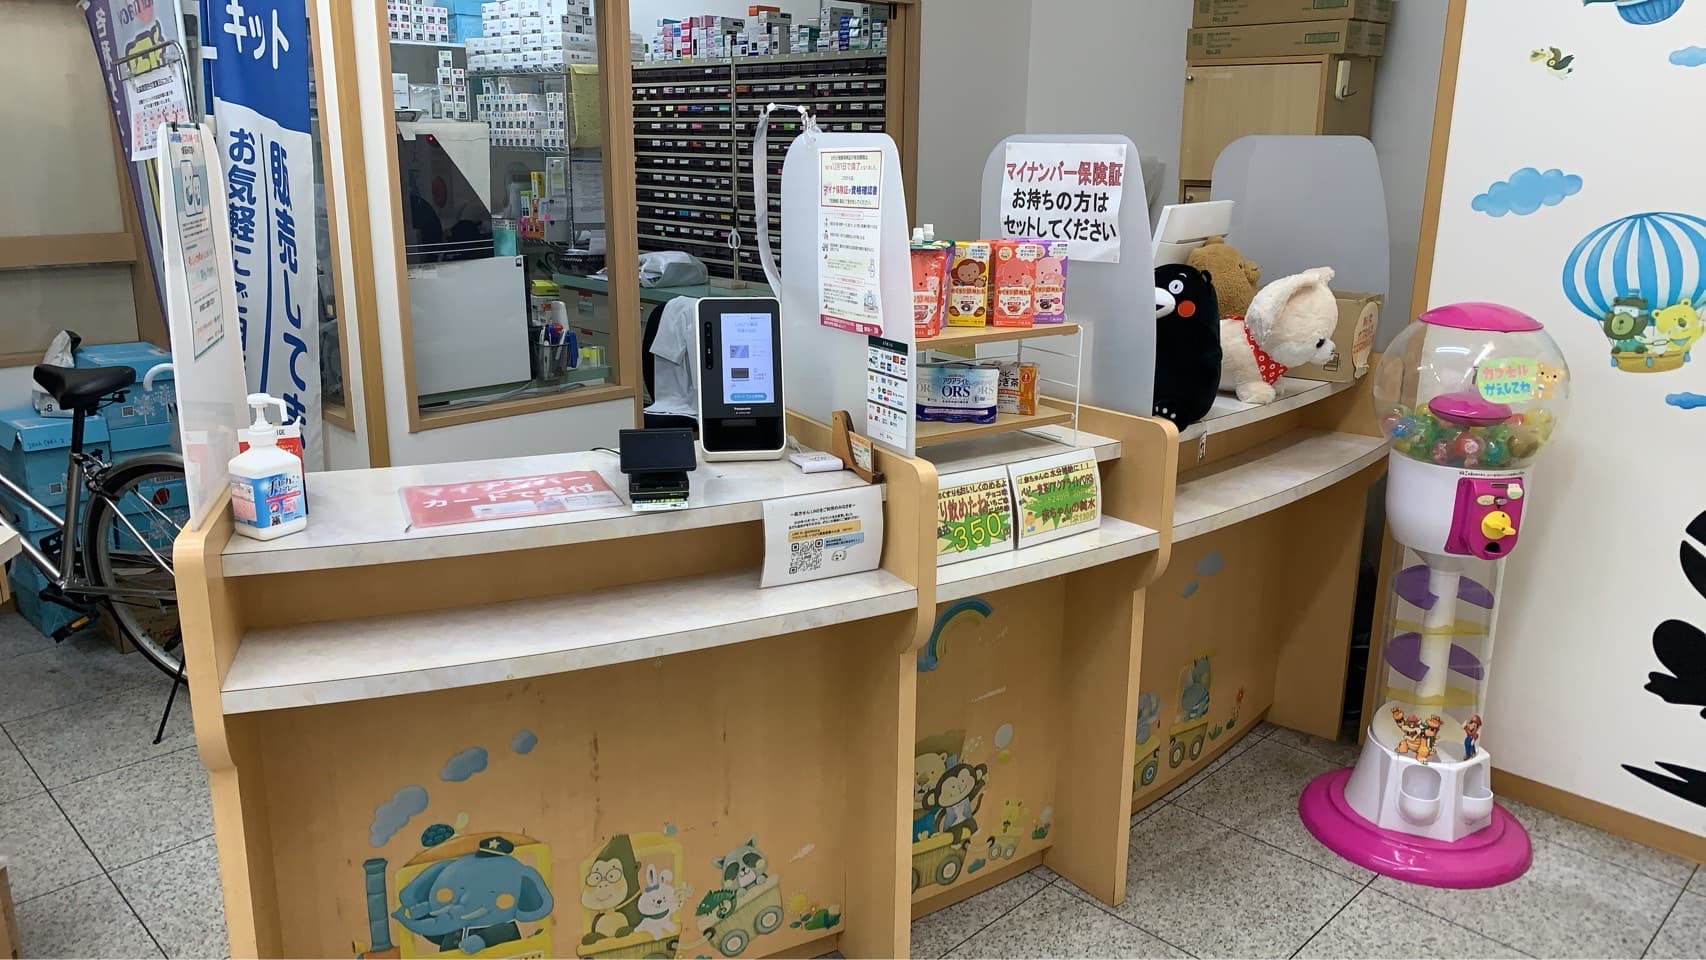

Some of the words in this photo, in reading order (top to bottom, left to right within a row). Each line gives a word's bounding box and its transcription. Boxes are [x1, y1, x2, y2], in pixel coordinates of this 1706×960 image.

[223, 0, 290, 70] キット
[1006, 160, 1123, 186] マイナンバー保険証
[1012, 188, 1109, 213] お持ちの方は
[1004, 215, 1117, 242] セットしてください
[942, 385, 971, 398] ORS
[422, 482, 595, 509] カードで受付
[938, 494, 988, 523] り飲めたね
[953, 511, 1001, 552] 350
